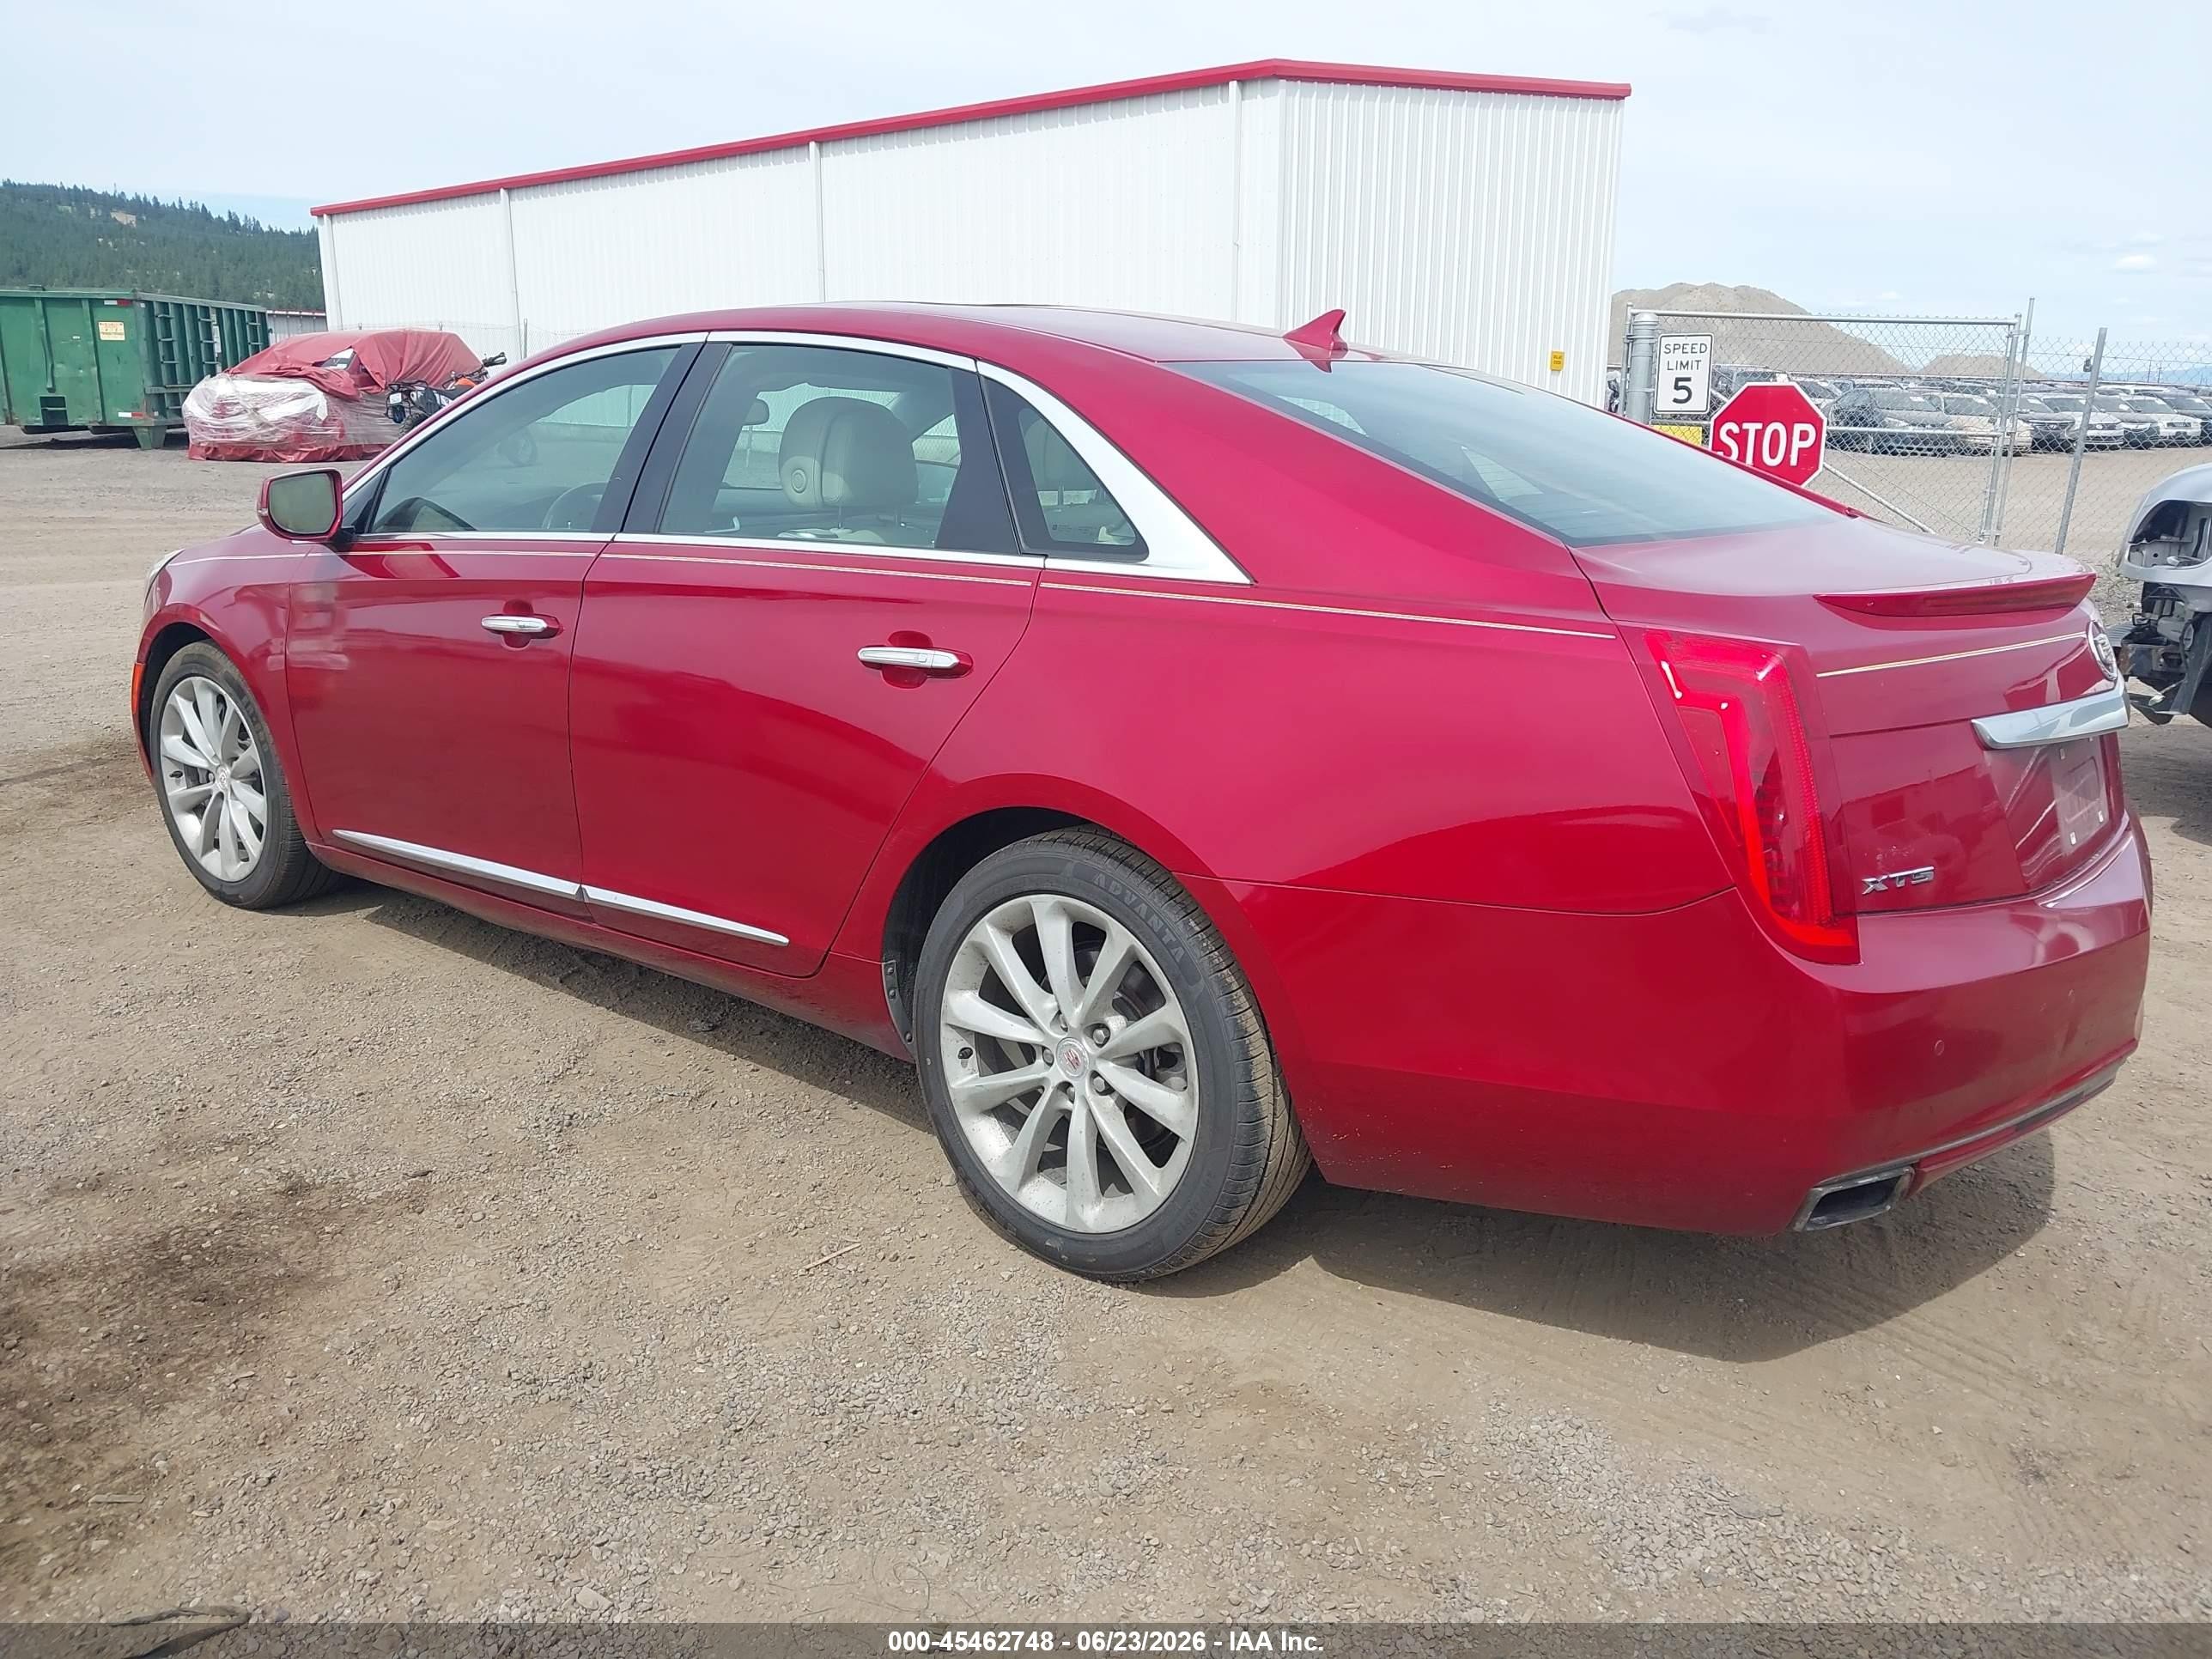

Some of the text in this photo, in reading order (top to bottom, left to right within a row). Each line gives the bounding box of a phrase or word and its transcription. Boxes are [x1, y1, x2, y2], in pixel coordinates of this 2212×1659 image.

[1663, 343, 1708, 355] SPEED
[1667, 359, 1702, 371] LIMIT
[1672, 376, 1693, 404] 5
[1717, 422, 1817, 467] STOP
[1861, 866, 1936, 895] XTS
[1092, 872, 1186, 963] ADVANTA
